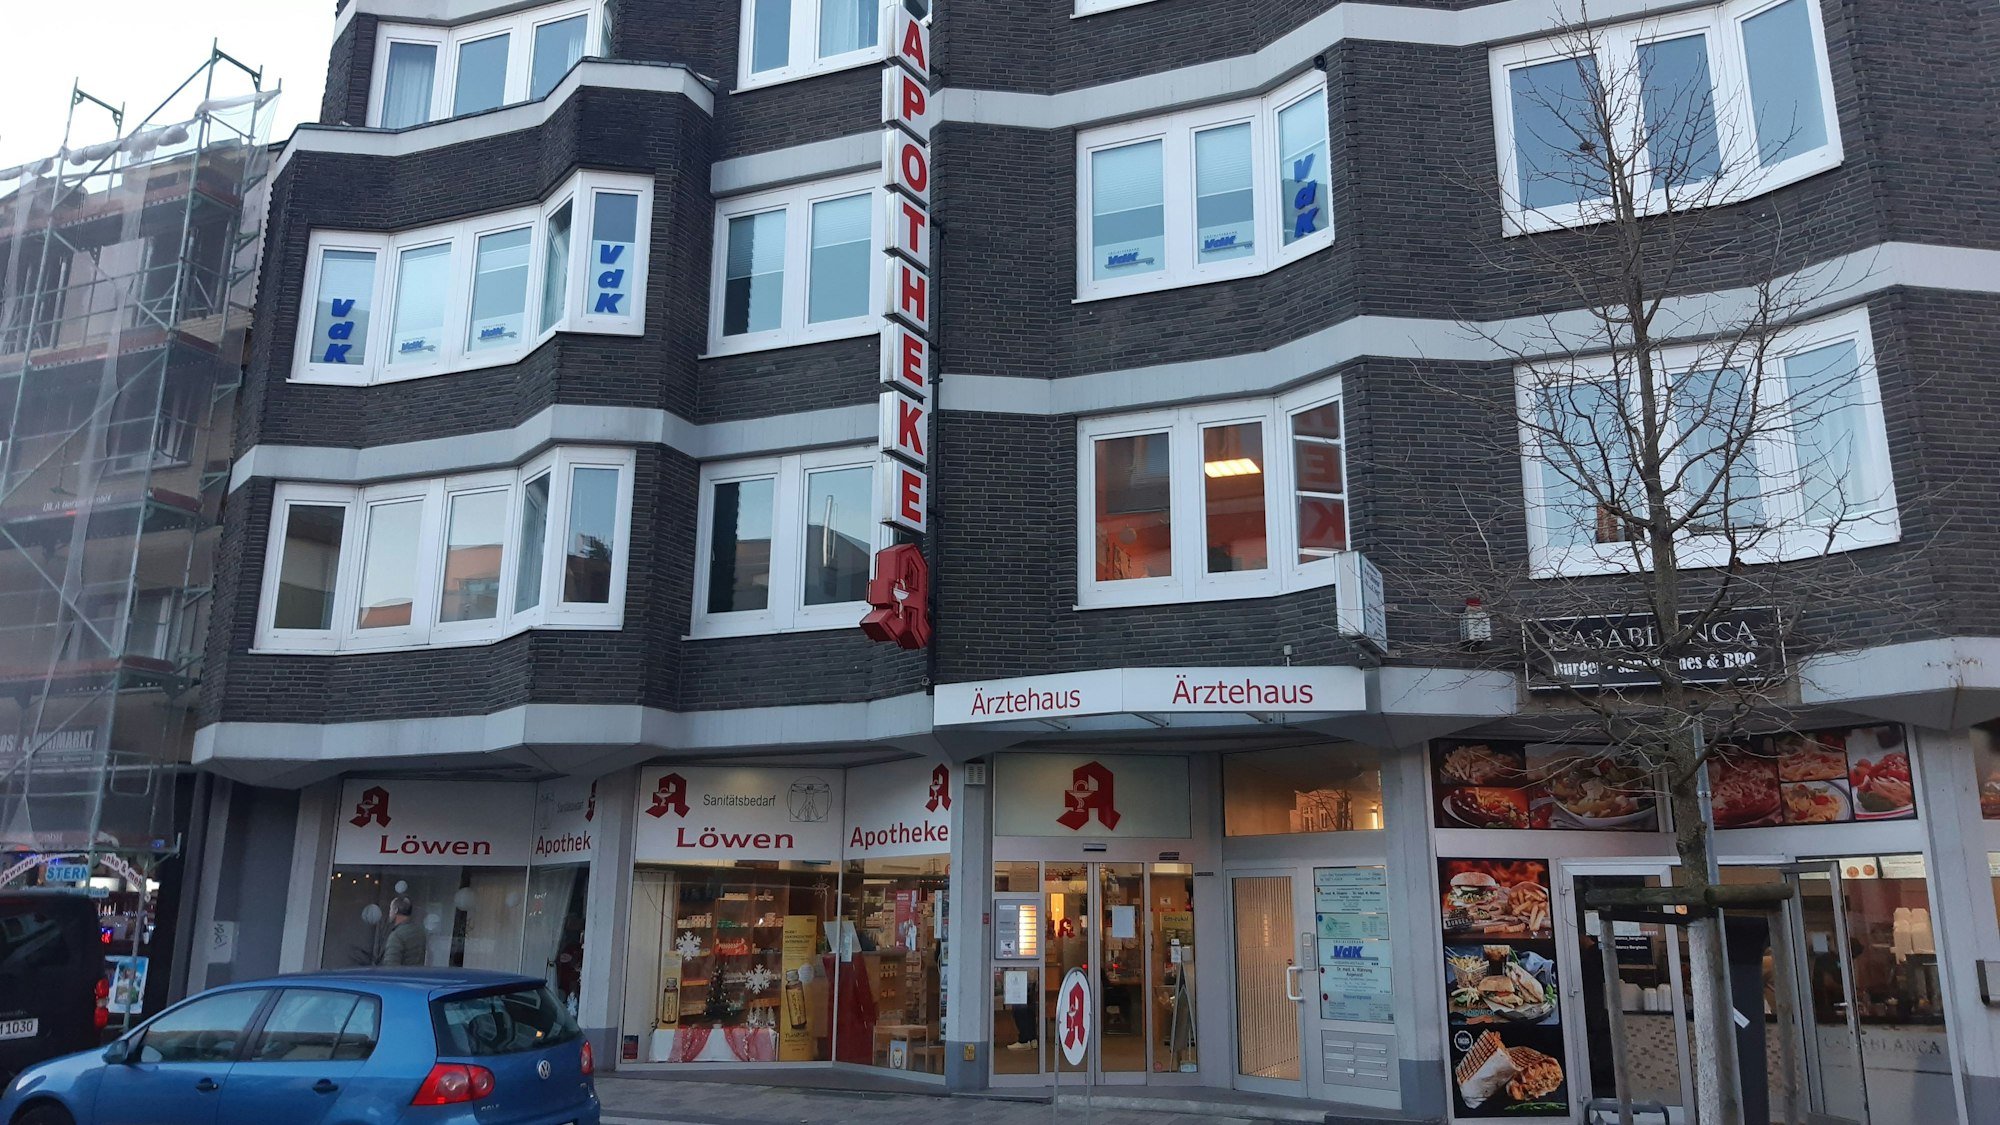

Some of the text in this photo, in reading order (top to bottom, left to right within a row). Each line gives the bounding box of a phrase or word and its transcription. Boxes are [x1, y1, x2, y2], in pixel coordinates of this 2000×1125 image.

[594, 244, 624, 314] VdK
[900, 19, 927, 523] APOTHEKE
[323, 298, 355, 363] VdK
[971, 687, 1081, 716] Ärztehaus
[1172, 674, 1314, 705] Ärztehaus
[703, 793, 776, 808] Sanitätsbedarf
[379, 834, 491, 855] Löwen
[676, 820, 949, 850] Löwen Apotheke
[1333, 945, 1363, 958] VdK
[5, 1020, 34, 1034] 1030
